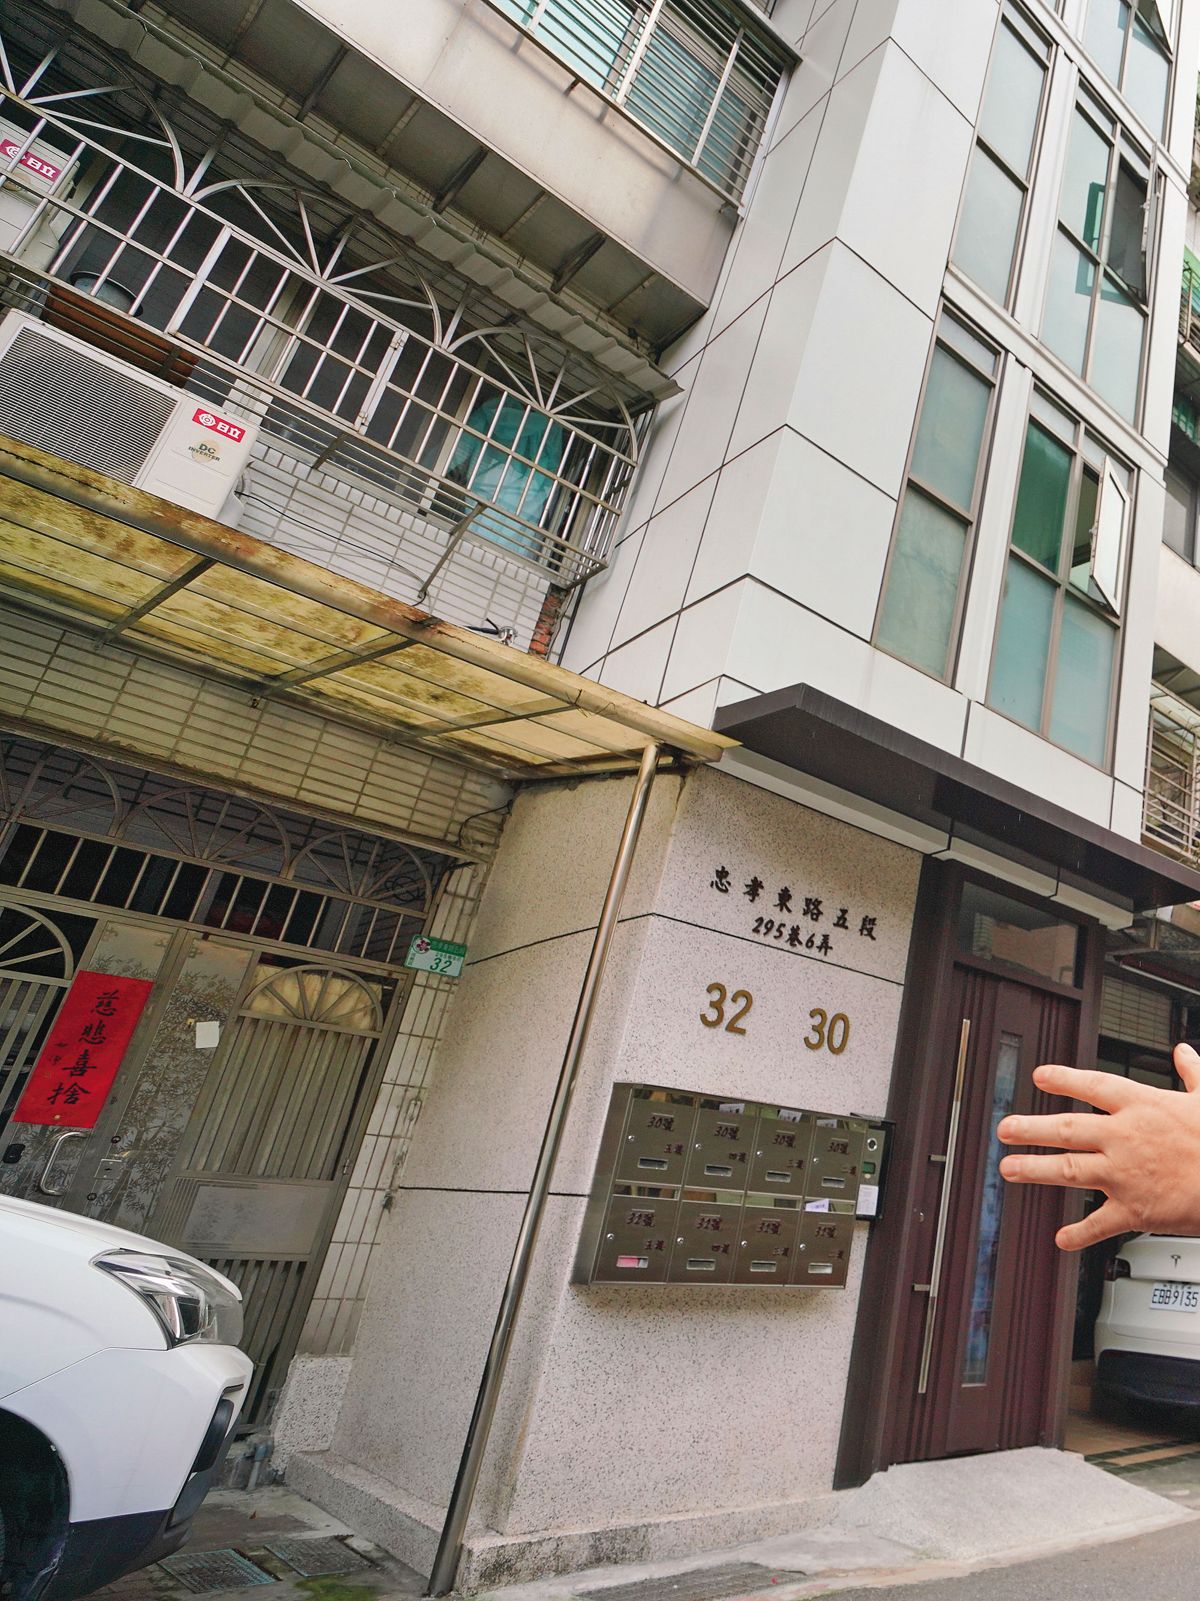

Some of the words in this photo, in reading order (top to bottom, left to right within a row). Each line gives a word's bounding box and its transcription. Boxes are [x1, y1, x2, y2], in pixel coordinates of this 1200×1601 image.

[26, 157, 57, 178] 日立
[216, 421, 241, 439] 日立
[188, 446, 221, 461] INVERTER
[198, 443, 216, 455] DC
[709, 865, 878, 941] 忠孝東路五段
[751, 916, 834, 956] 295巷6弄
[429, 957, 453, 973] 32
[699, 982, 753, 1036] 32
[803, 1008, 850, 1055] 30
[46, 989, 121, 1105] 慈悲喜捨
